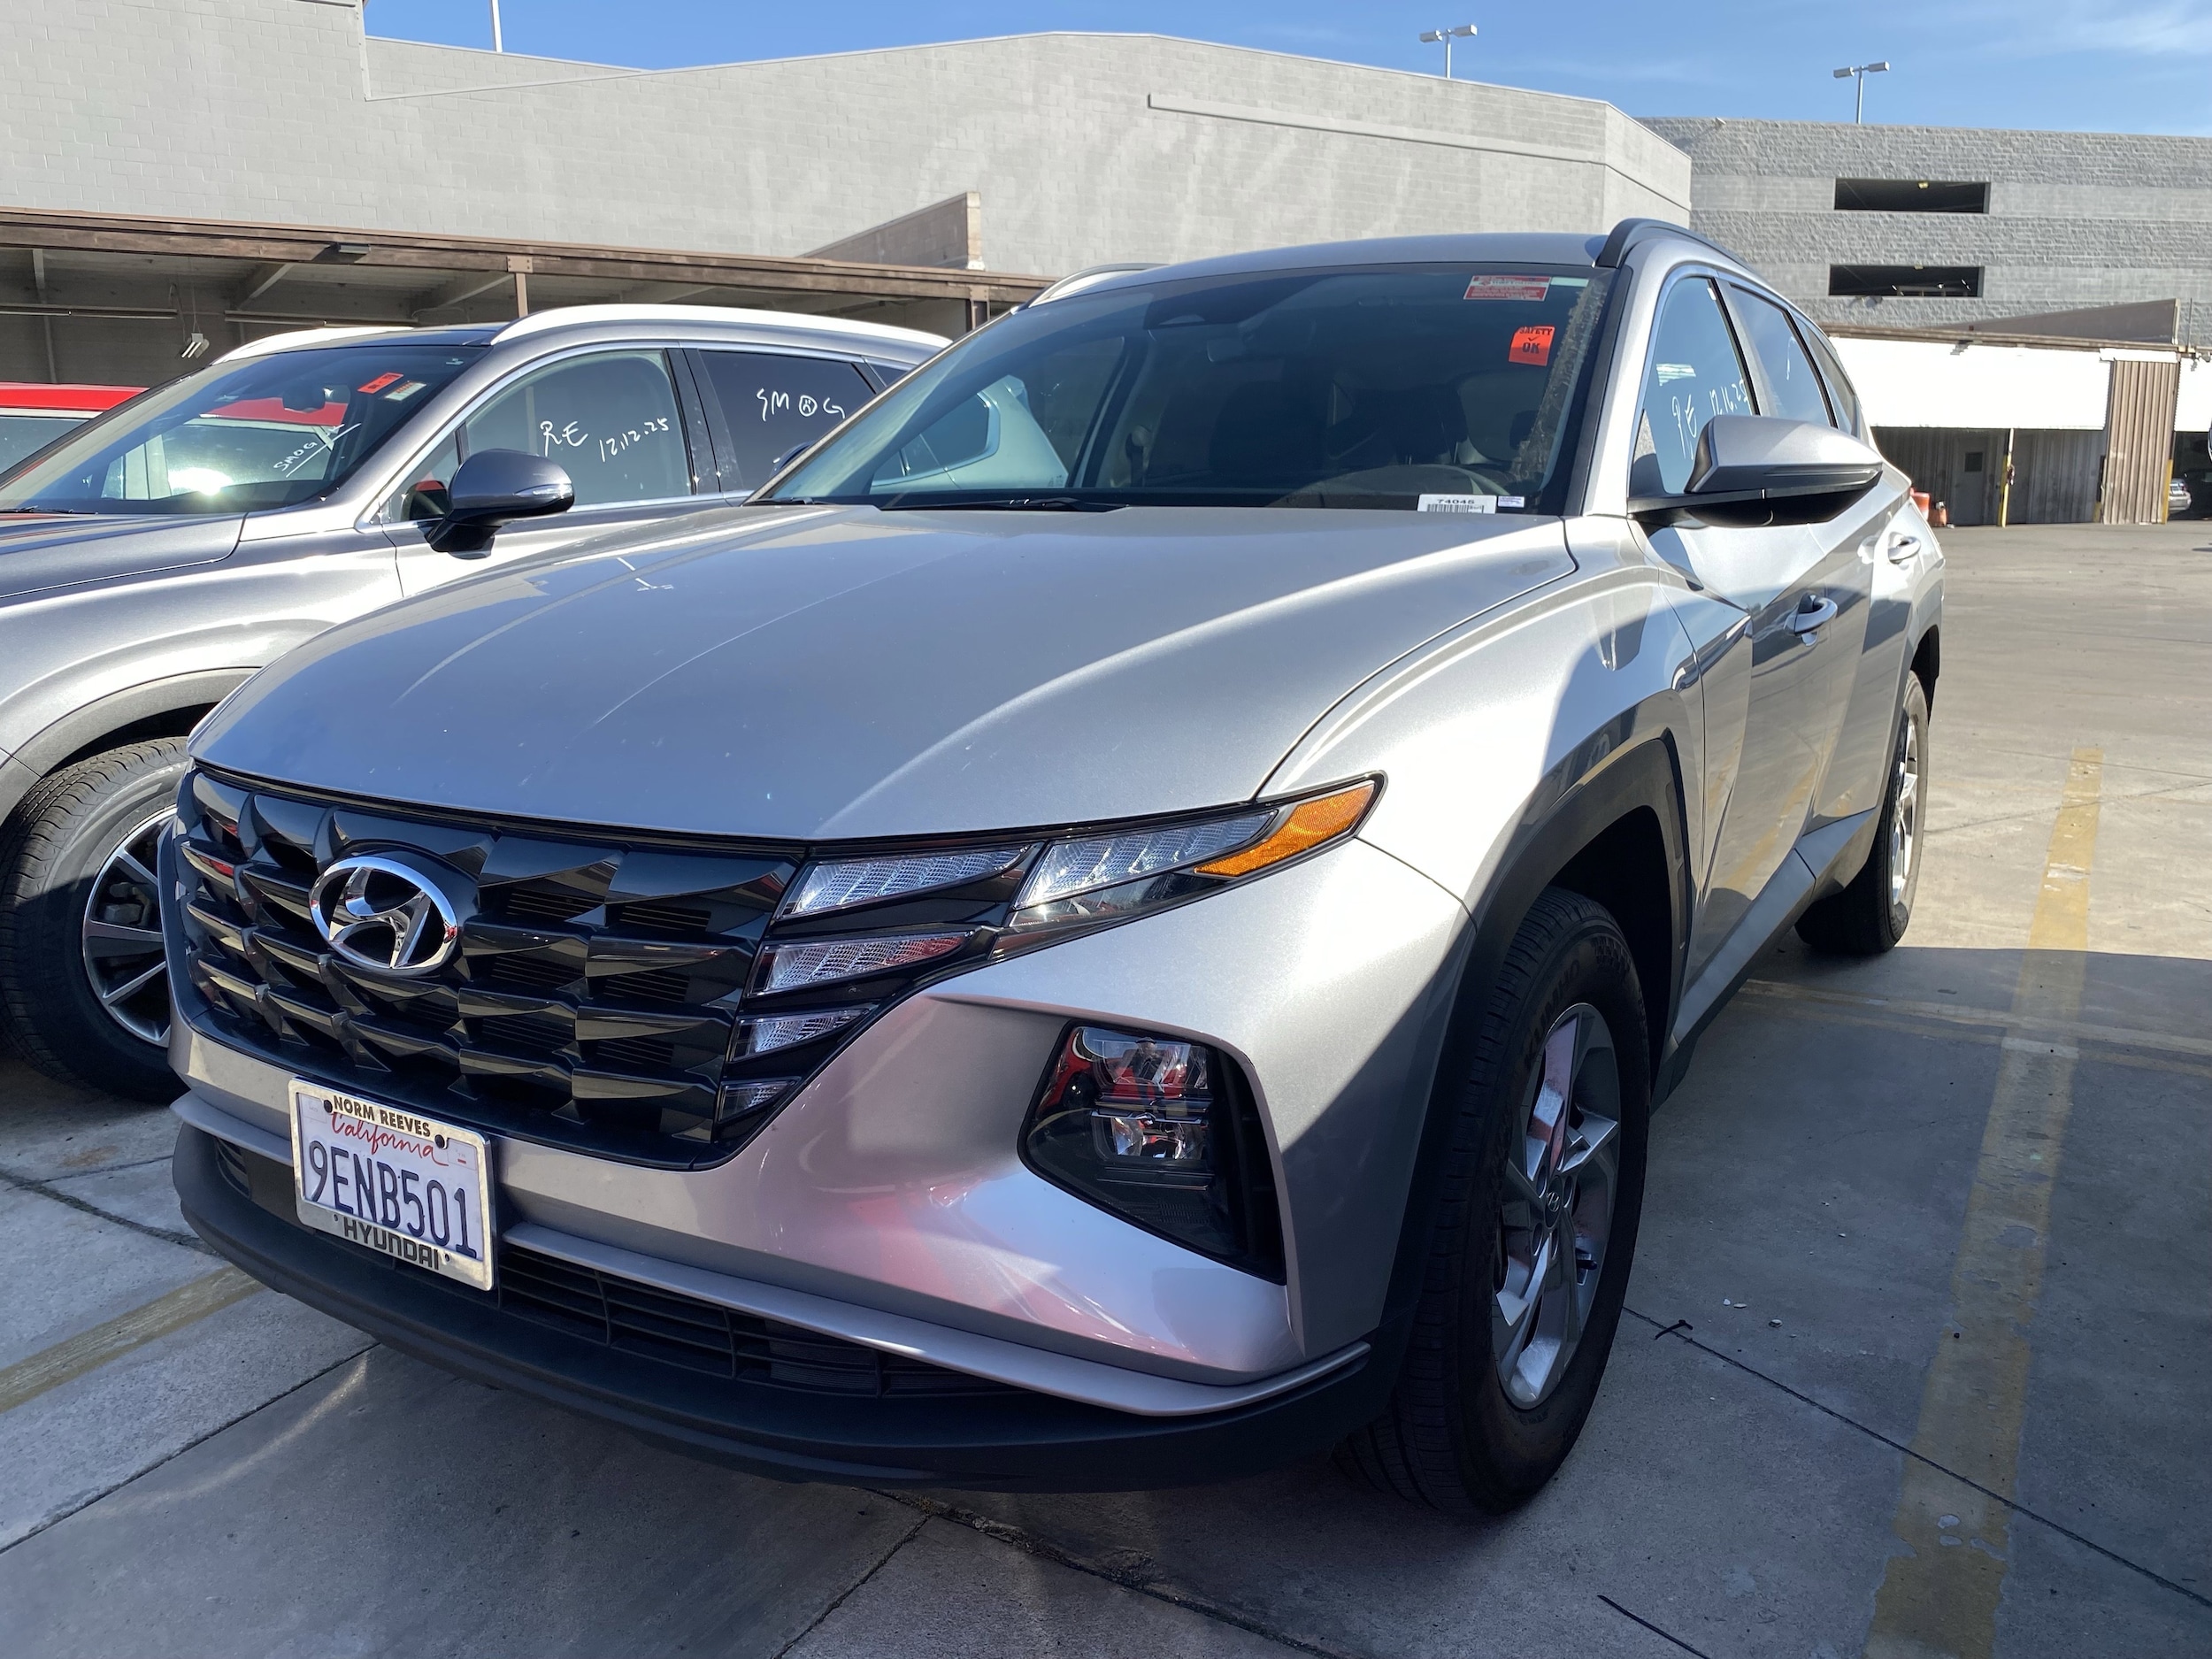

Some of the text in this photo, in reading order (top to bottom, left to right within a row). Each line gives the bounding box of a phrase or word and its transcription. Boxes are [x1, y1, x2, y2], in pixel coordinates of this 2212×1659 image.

[1522, 342, 1540, 354] OK
[273, 442, 319, 472] SMOG
[540, 420, 589, 457] RE
[334, 1095, 431, 1138] NORM REEVES
[309, 1140, 477, 1259] 9ENB501
[344, 1217, 440, 1271] HYUNDAI
